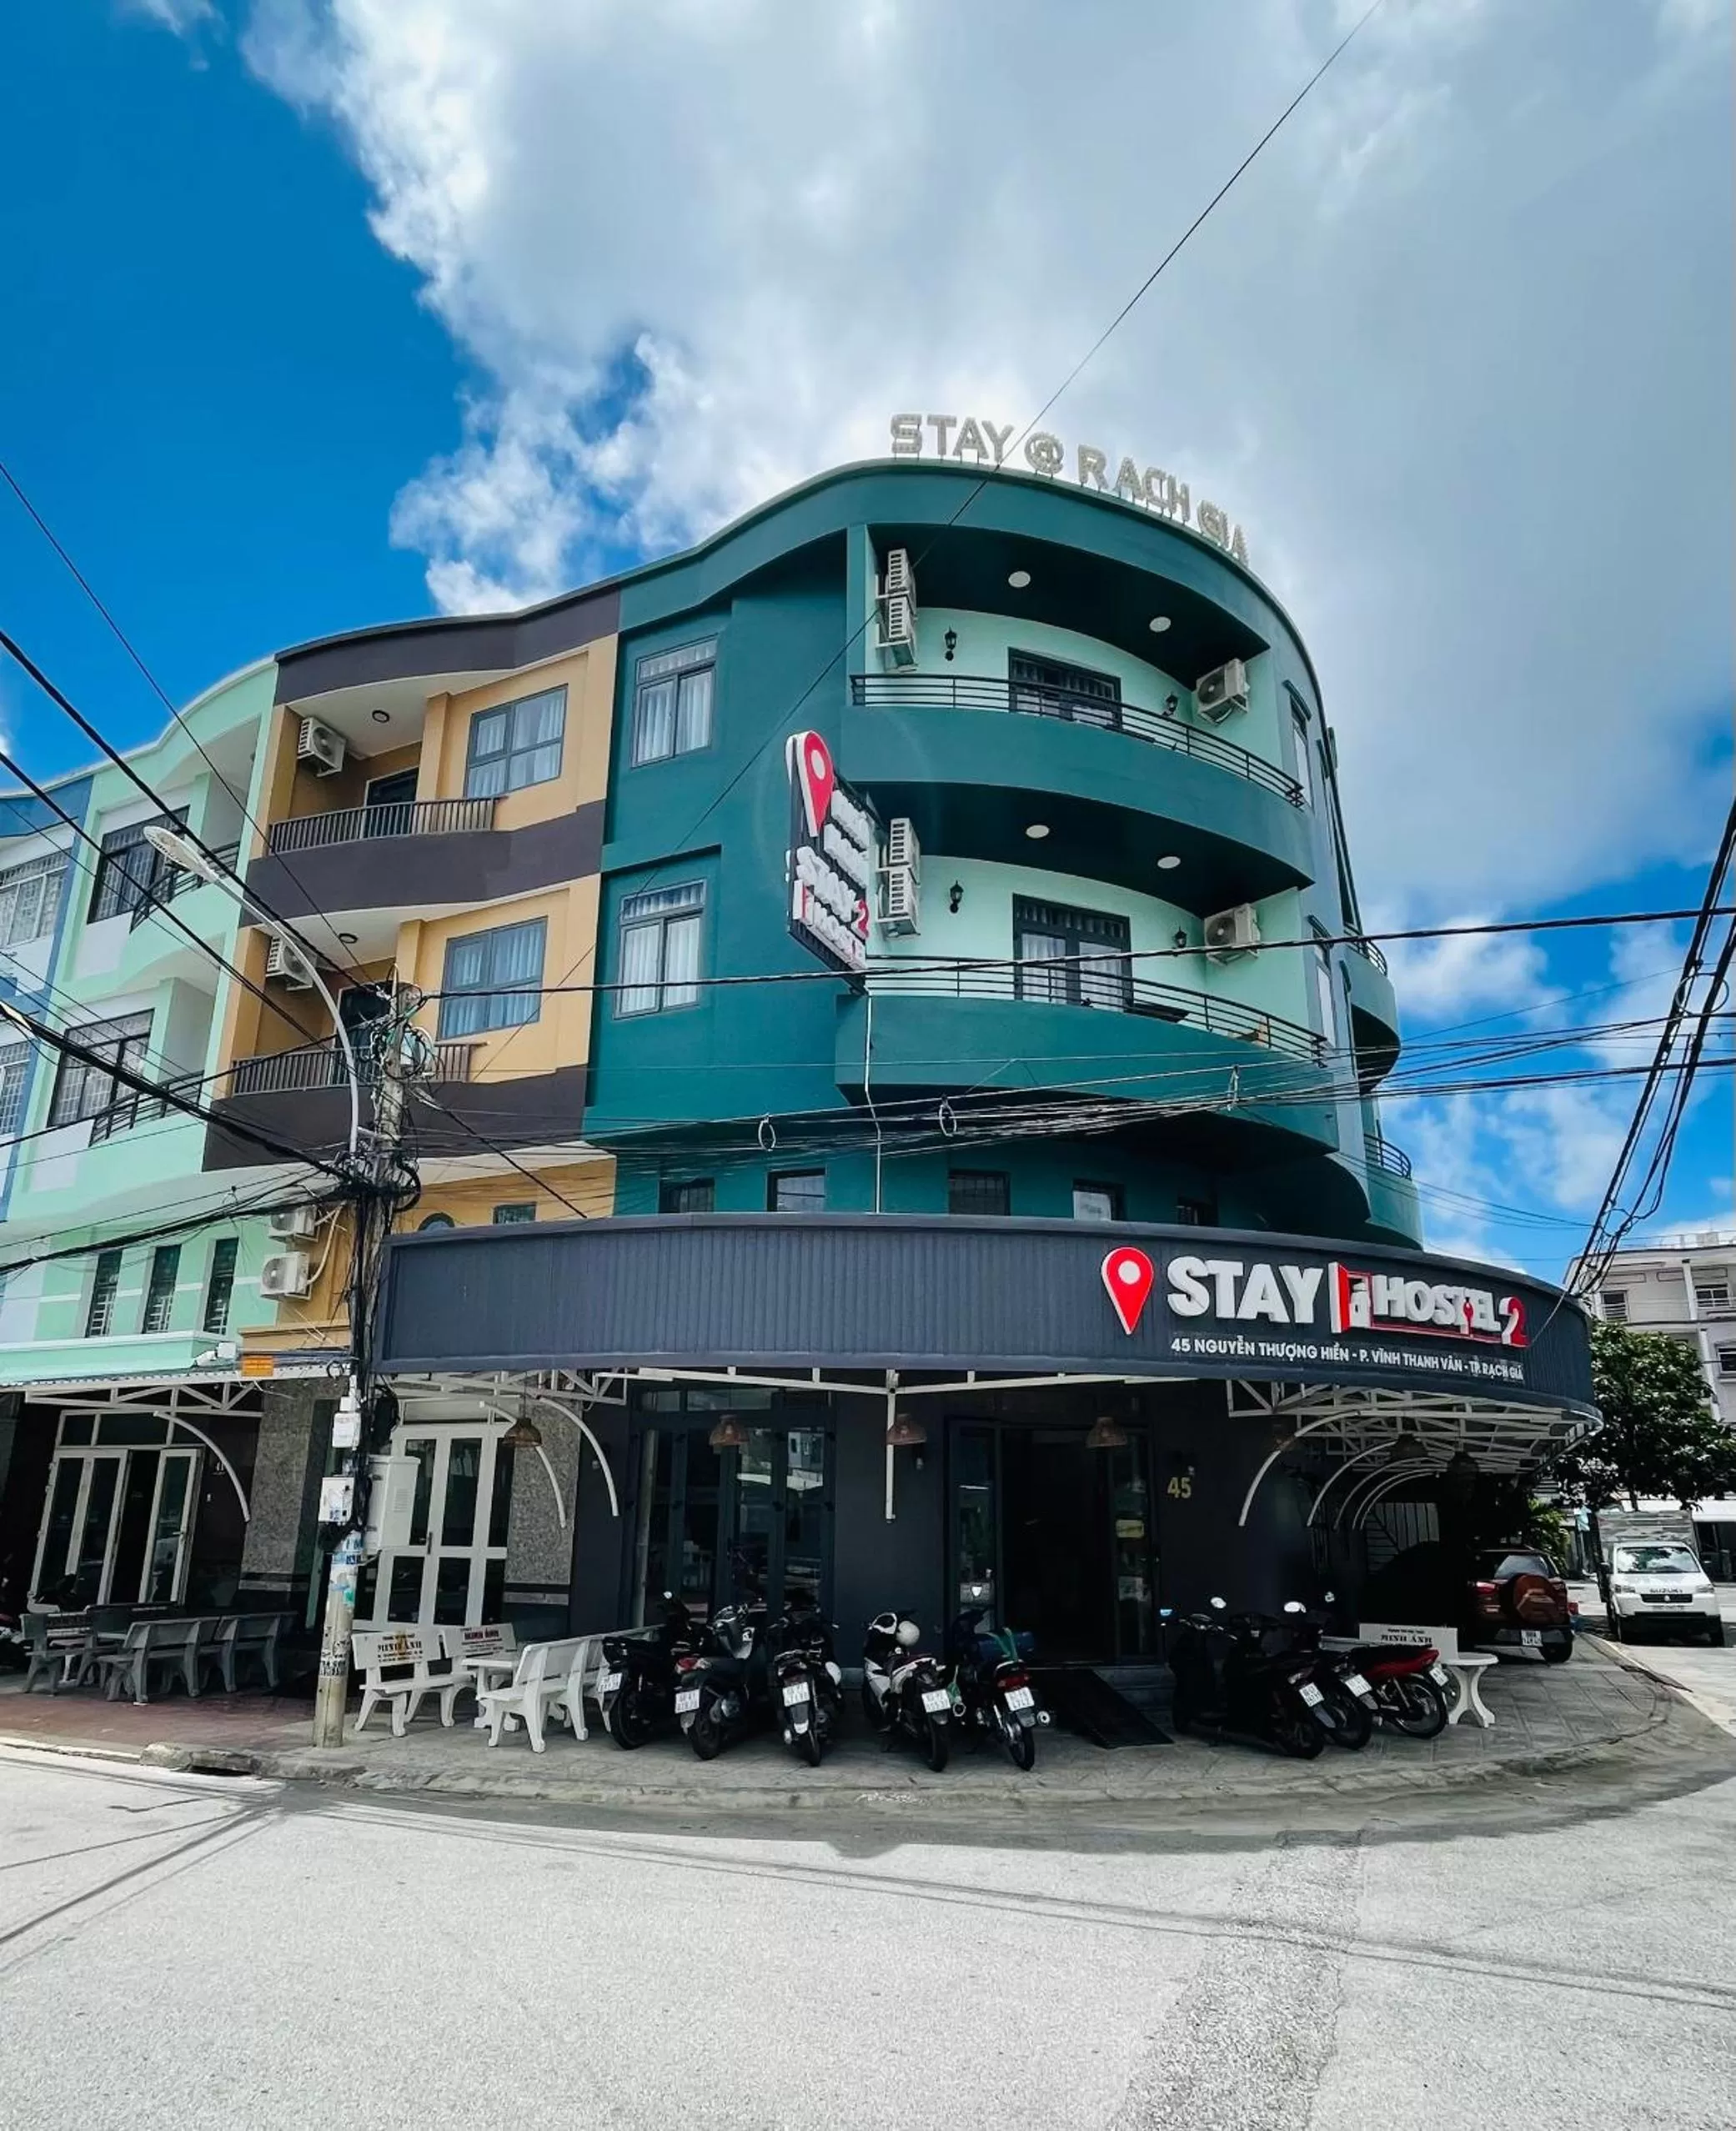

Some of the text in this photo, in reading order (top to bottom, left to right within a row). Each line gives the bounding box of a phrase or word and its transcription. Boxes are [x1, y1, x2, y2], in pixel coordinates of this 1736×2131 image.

[890, 414, 1015, 464] STAY
[1025, 431, 1065, 474] @
[1077, 444, 1191, 523] RACH
[850, 899, 870, 939] 2
[1167, 1256, 1528, 1347] STAY HOSTEL 2
[1171, 1338, 1191, 1352] 45
[1194, 1335, 1255, 1356] NGUYỄN
[1258, 1342, 1317, 1361] THƯỢNG
[1359, 1349, 1369, 1362] P.
[1372, 1347, 1401, 1366] VĨNH
[1402, 1352, 1438, 1370] THANH
[1440, 1357, 1463, 1372] VÂN
[1483, 1362, 1508, 1379] RẠCH
[1167, 1477, 1192, 1498] 45
